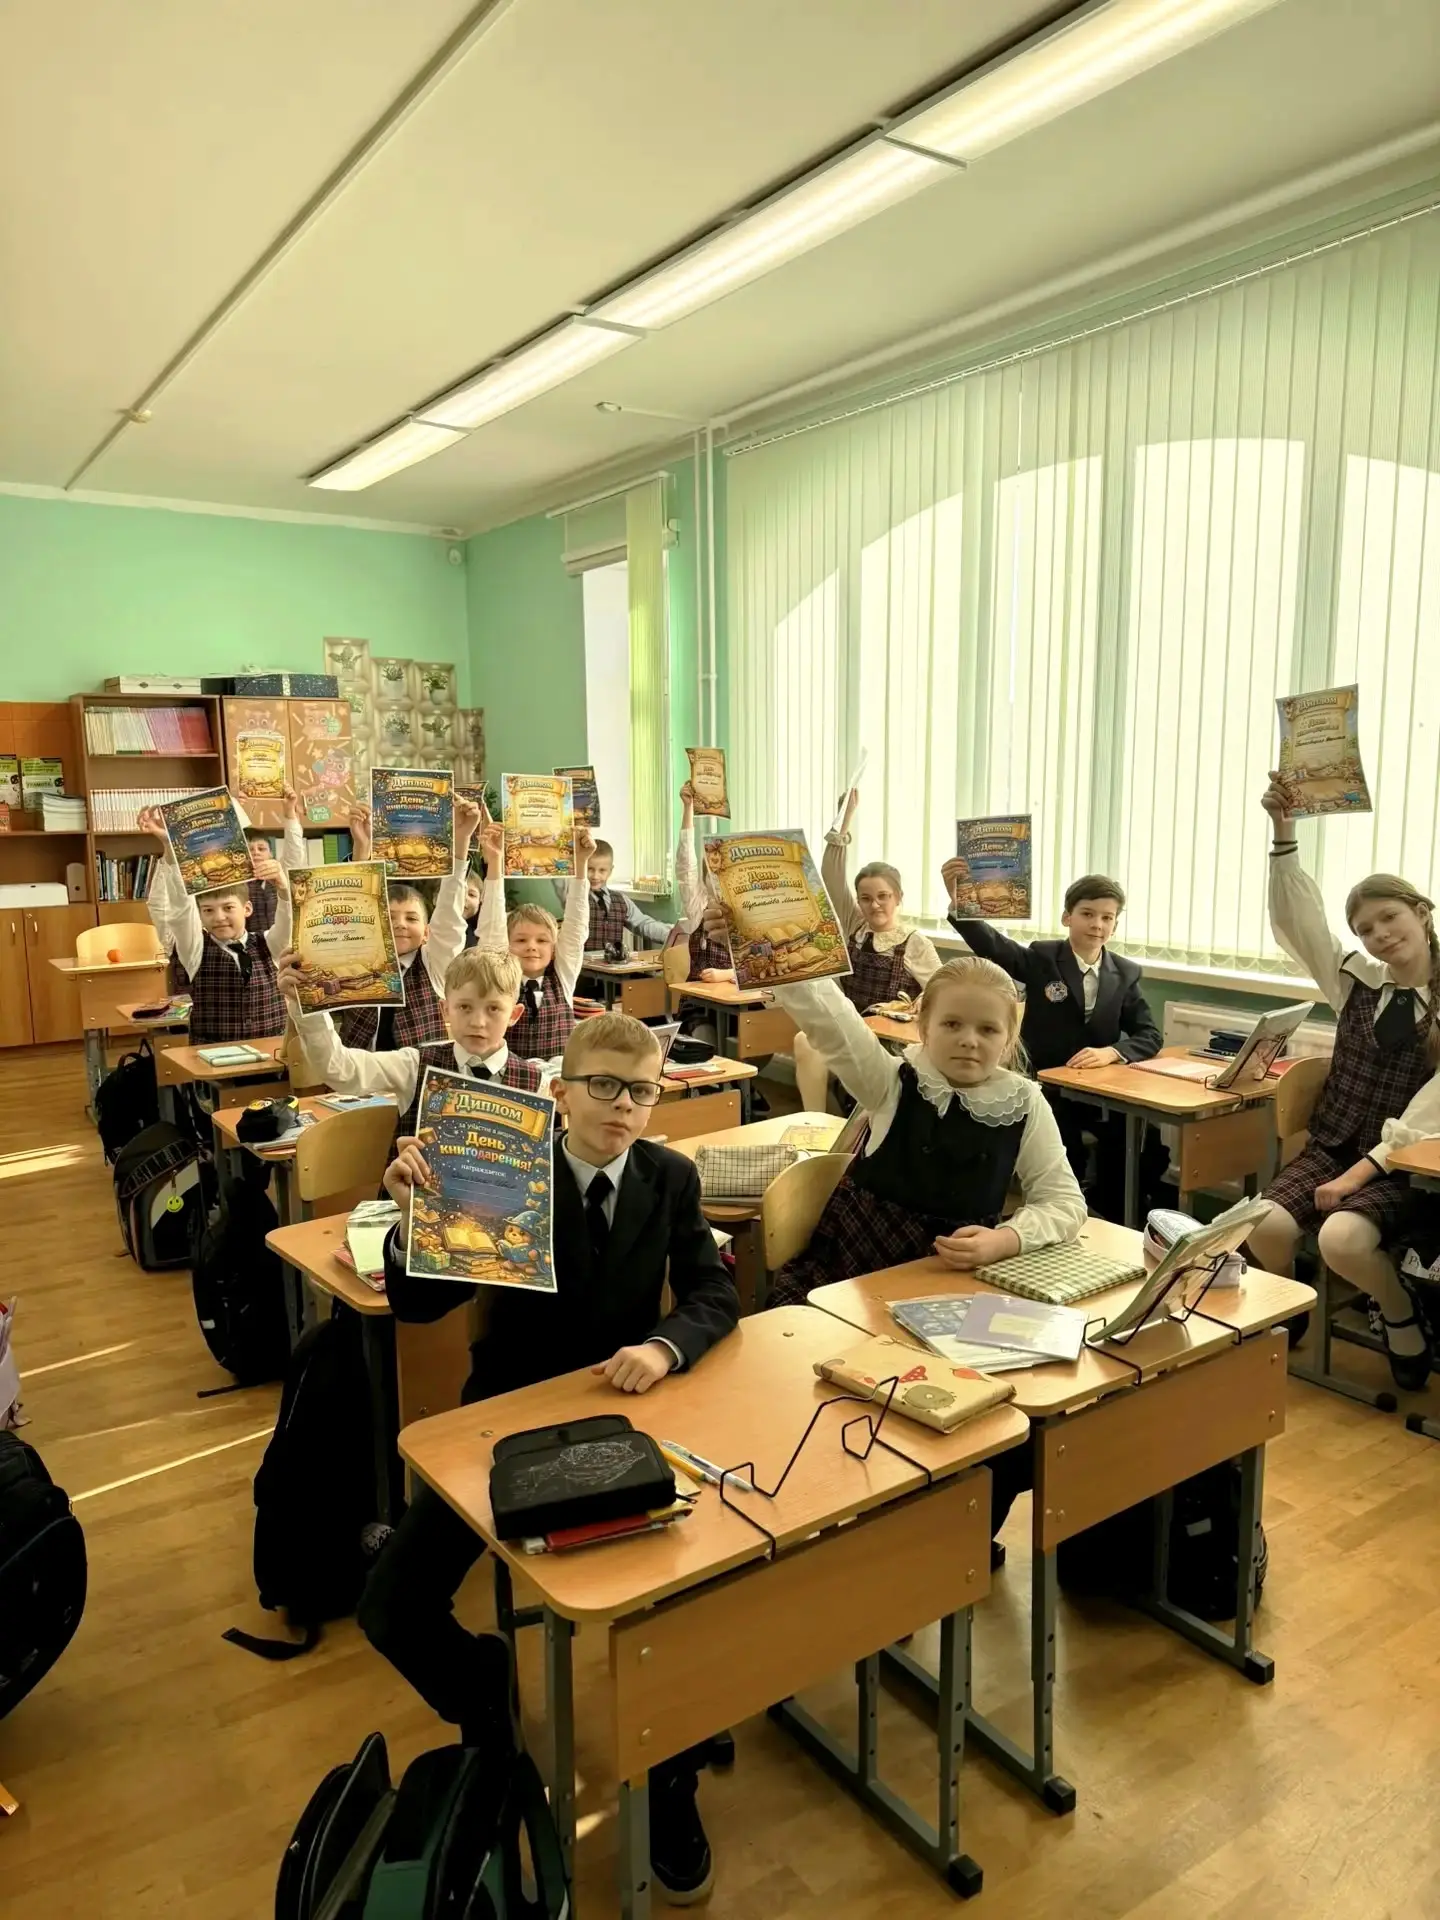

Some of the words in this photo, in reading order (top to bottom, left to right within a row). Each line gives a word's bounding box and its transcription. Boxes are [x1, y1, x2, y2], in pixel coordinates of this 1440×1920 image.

[392, 778, 433, 789] Диплом
[400, 796, 424, 804] День
[973, 826, 1012, 836] Диплом
[981, 843, 1004, 851] День
[730, 846, 784, 862] Диплом
[748, 871, 779, 883] День
[315, 877, 363, 893] Диплом
[733, 880, 803, 895] книгодарения!
[323, 904, 353, 916] День
[306, 915, 376, 928] книгодарения!
[456, 1093, 523, 1124] Диплом
[467, 1123, 492, 1134] участие
[466, 1131, 506, 1151] День
[440, 1144, 533, 1171] книгодарения!
